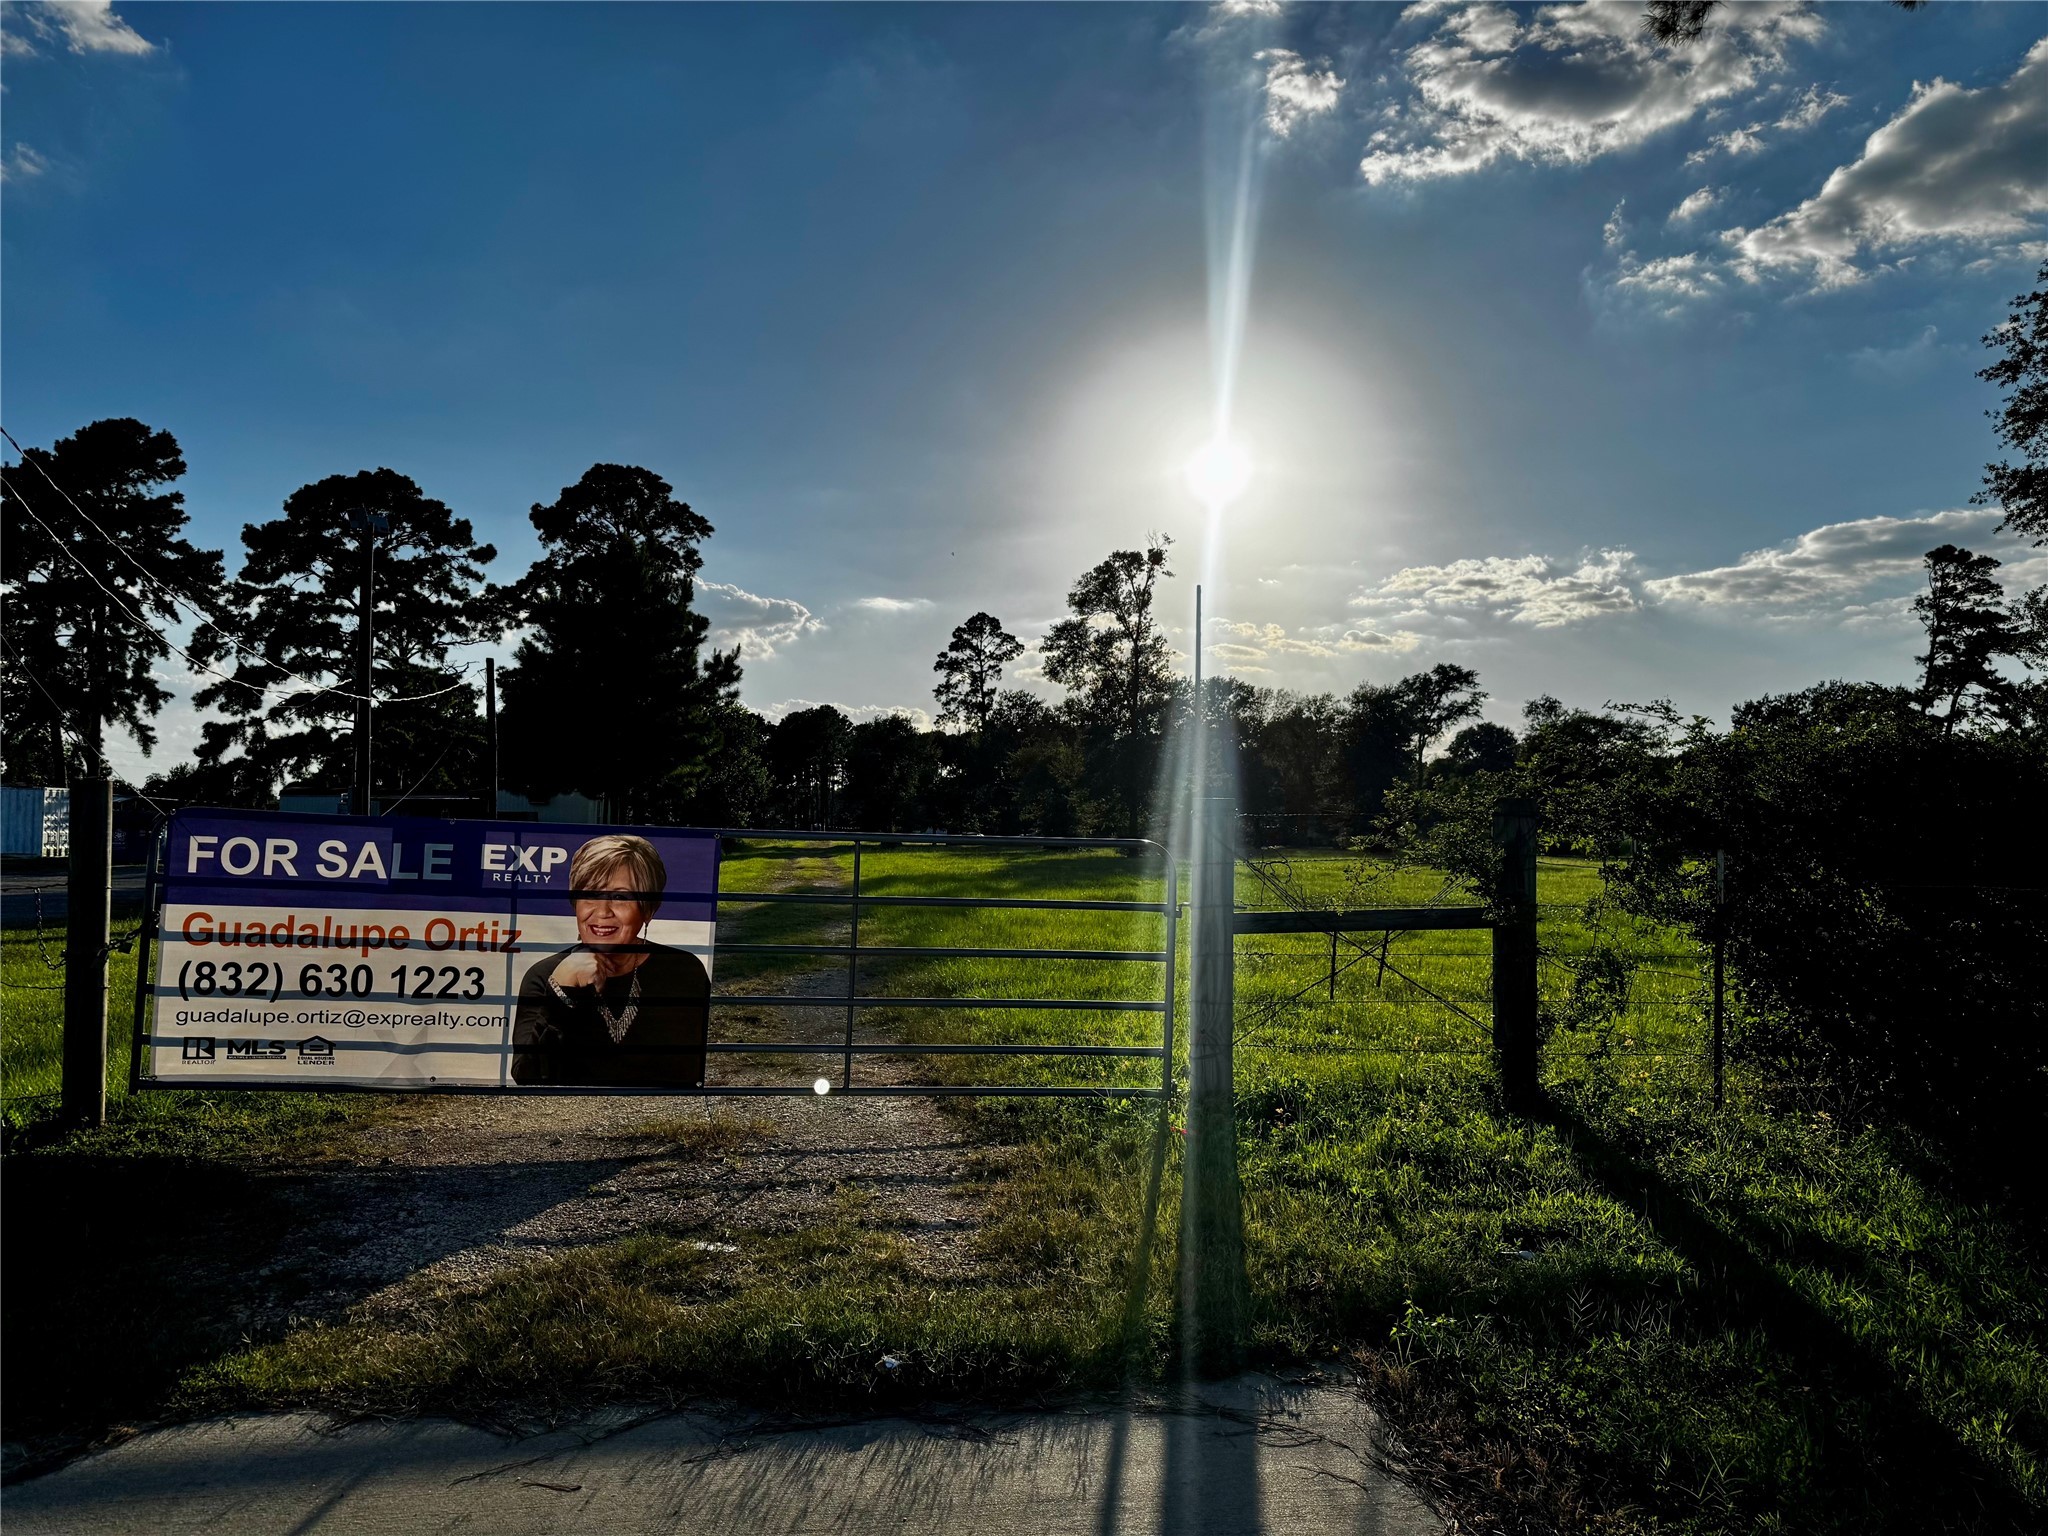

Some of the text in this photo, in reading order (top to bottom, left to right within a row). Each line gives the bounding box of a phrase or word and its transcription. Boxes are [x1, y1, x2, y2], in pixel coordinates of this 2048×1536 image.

[187, 835, 454, 881] FOR SALE
[480, 843, 568, 873] EXP
[492, 872, 552, 884] REALTY
[182, 911, 522, 958] Guadalupe Ortiz
[178, 960, 485, 1003] (832) 630 1223
[175, 1008, 510, 1030] guadalupe.ortiz@exprealty.com
[227, 1040, 286, 1055] MLS
